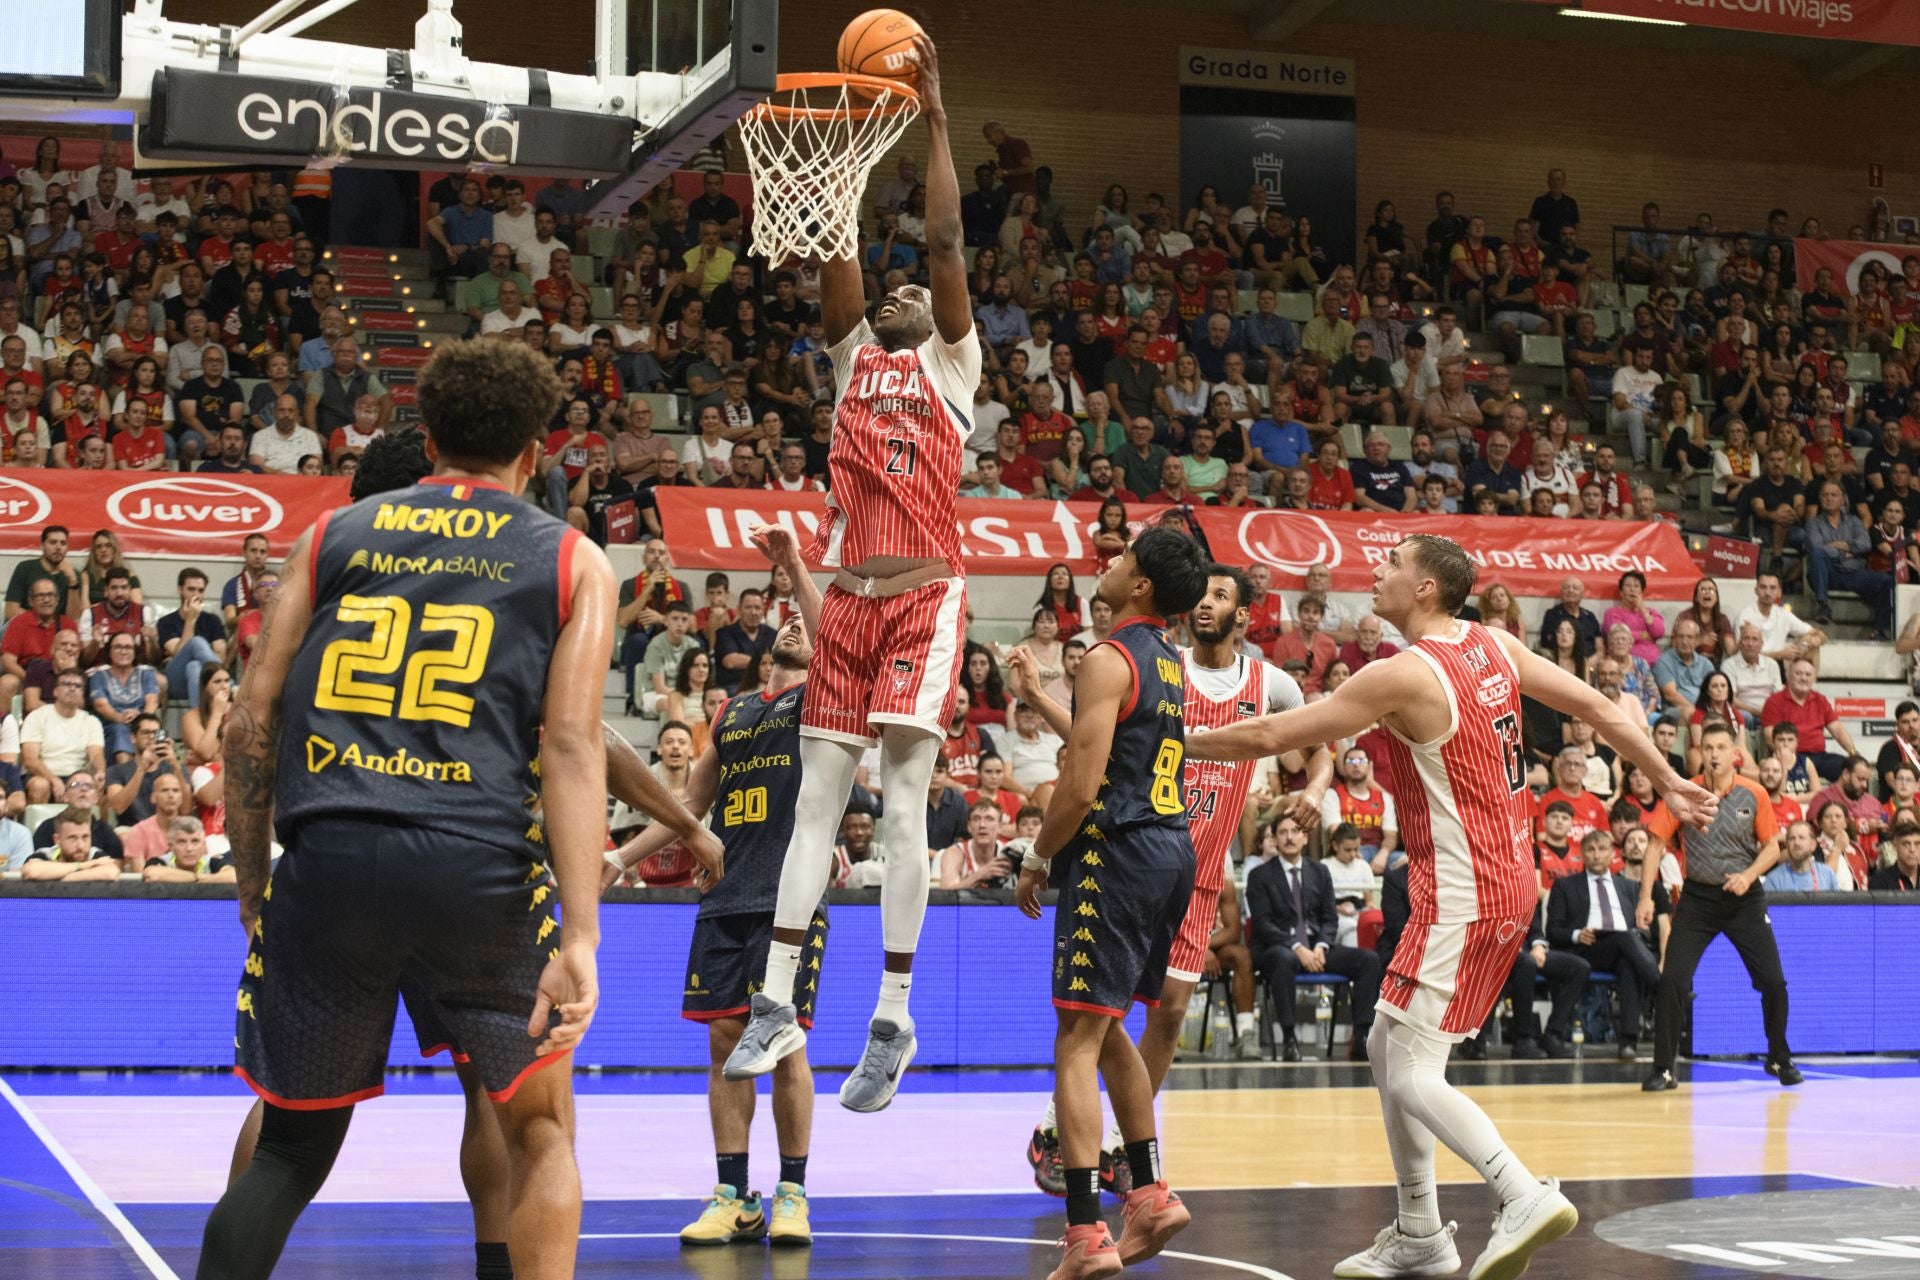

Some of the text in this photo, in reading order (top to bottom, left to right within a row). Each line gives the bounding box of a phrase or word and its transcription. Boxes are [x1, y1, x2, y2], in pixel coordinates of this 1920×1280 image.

[1189, 55, 1347, 85] Grada Norte
[237, 91, 519, 164] endesa
[859, 370, 929, 400] UCA
[872, 398, 932, 418] MURCIA
[886, 438, 916, 476] 21
[128, 498, 261, 523] Juver
[372, 552, 514, 583] MORABANC
[1492, 549, 1537, 569] DE
[1540, 552, 1667, 573] MURCIA
[314, 593, 495, 728] 22
[339, 742, 472, 783] Andorra
[729, 754, 791, 778] Andorra
[1151, 738, 1185, 815] 8
[724, 786, 768, 827] 20
[1188, 788, 1217, 821] 24
